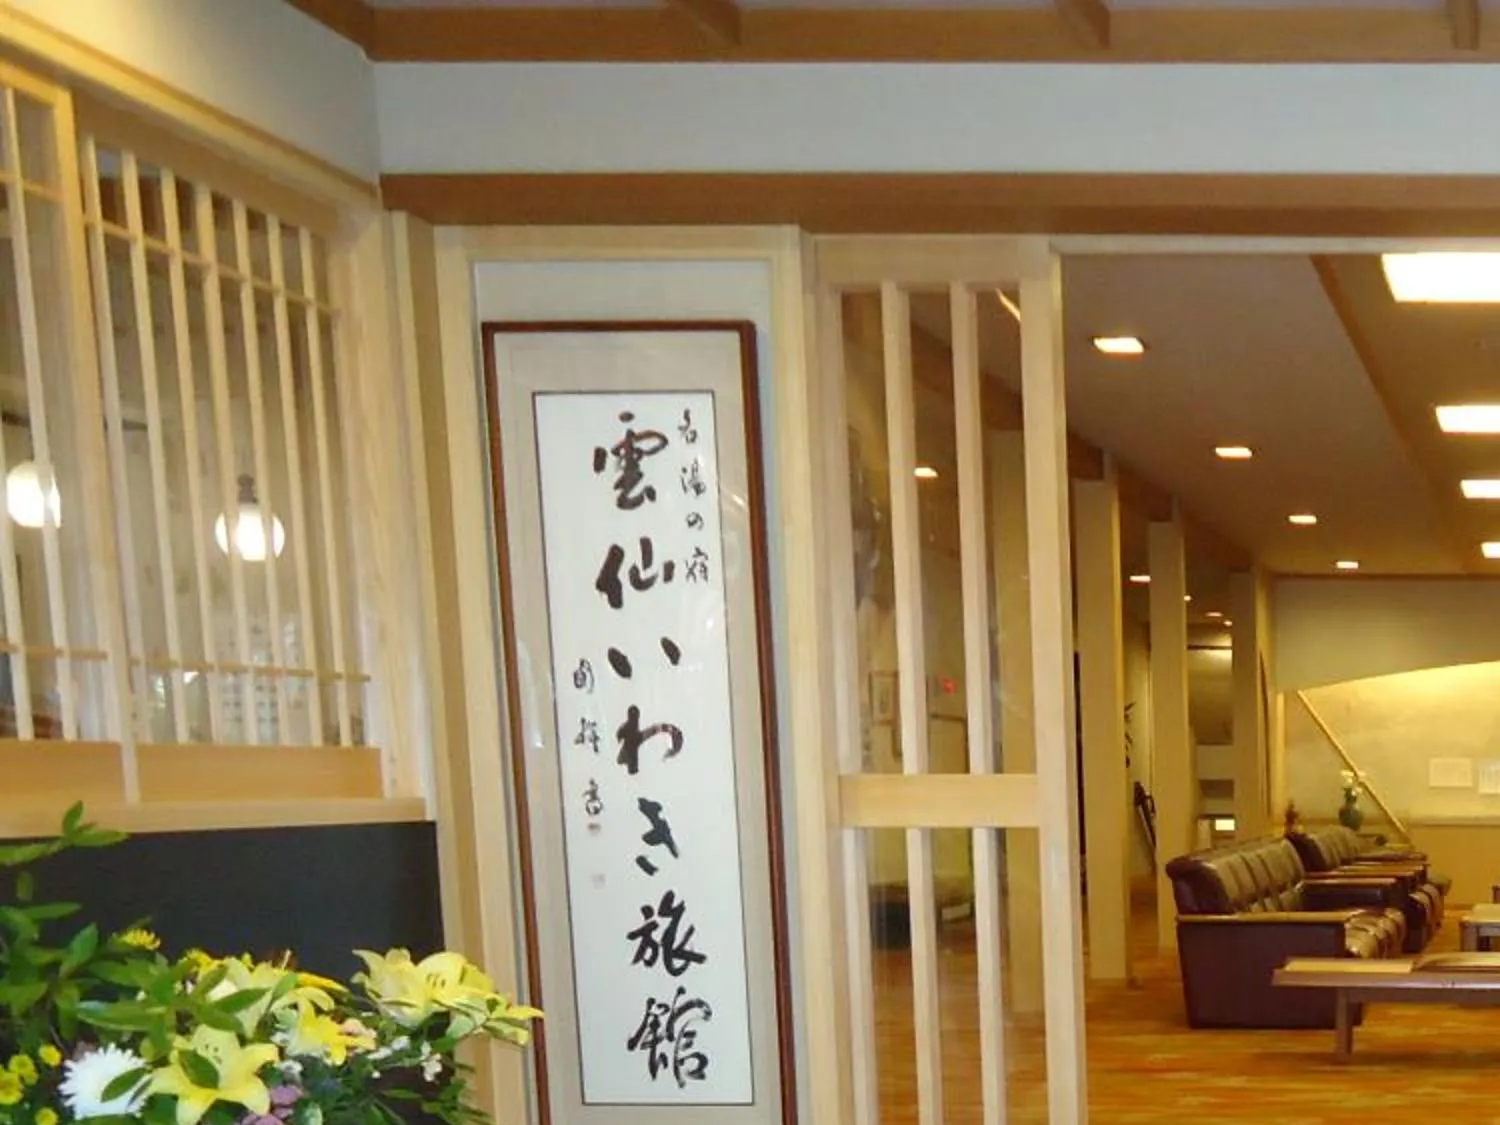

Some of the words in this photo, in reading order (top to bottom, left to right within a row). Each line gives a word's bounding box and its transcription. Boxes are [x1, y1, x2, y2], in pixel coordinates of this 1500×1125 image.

[678, 407, 710, 582] 名湯の宿
[592, 411, 711, 1089] 雲仙いわき旅館
